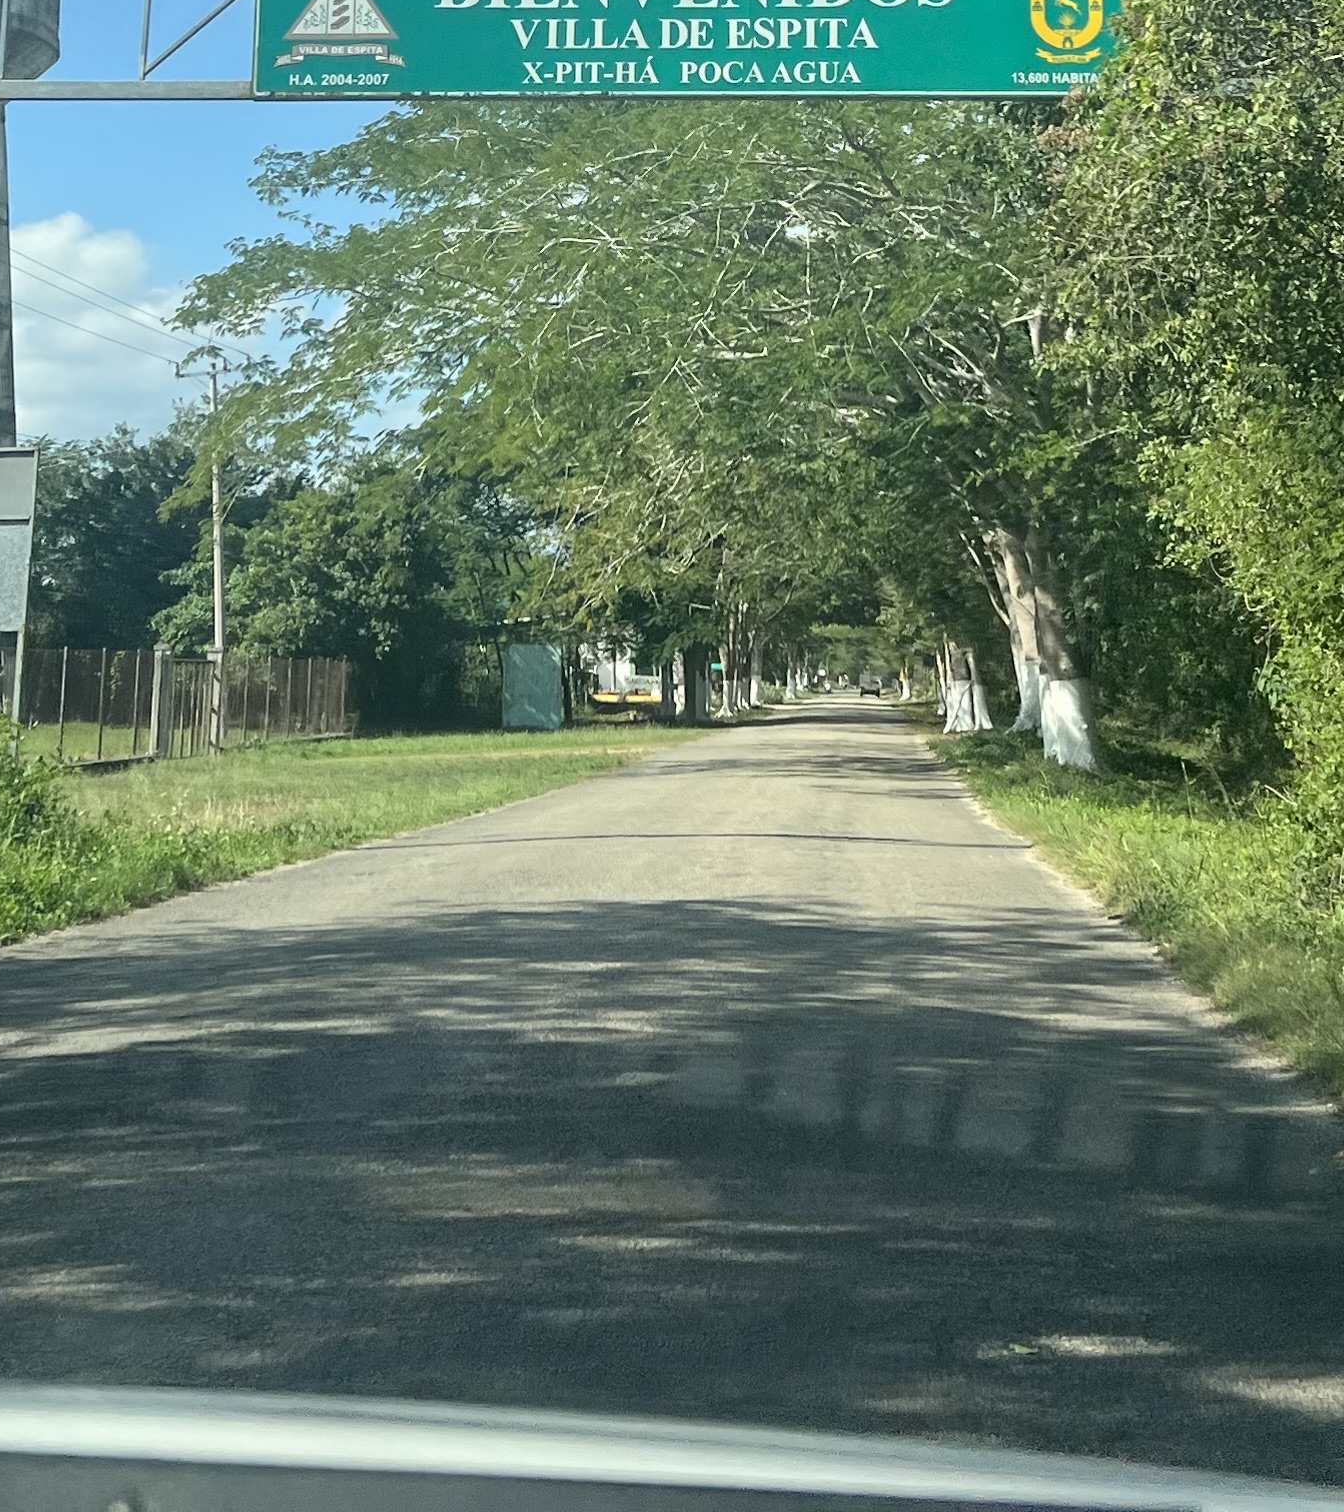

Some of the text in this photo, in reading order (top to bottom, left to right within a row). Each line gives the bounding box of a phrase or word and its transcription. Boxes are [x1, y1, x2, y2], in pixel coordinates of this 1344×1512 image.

[510, 17, 879, 49] VILLA DE ESPITA
[298, 45, 384, 55] VILLA DE ESPITA
[522, 56, 861, 84] X-PIT-HÁ POCA AGUA
[289, 73, 390, 86] H.A. 2004-2007
[1011, 72, 1099, 85] 13,600 HABITA
